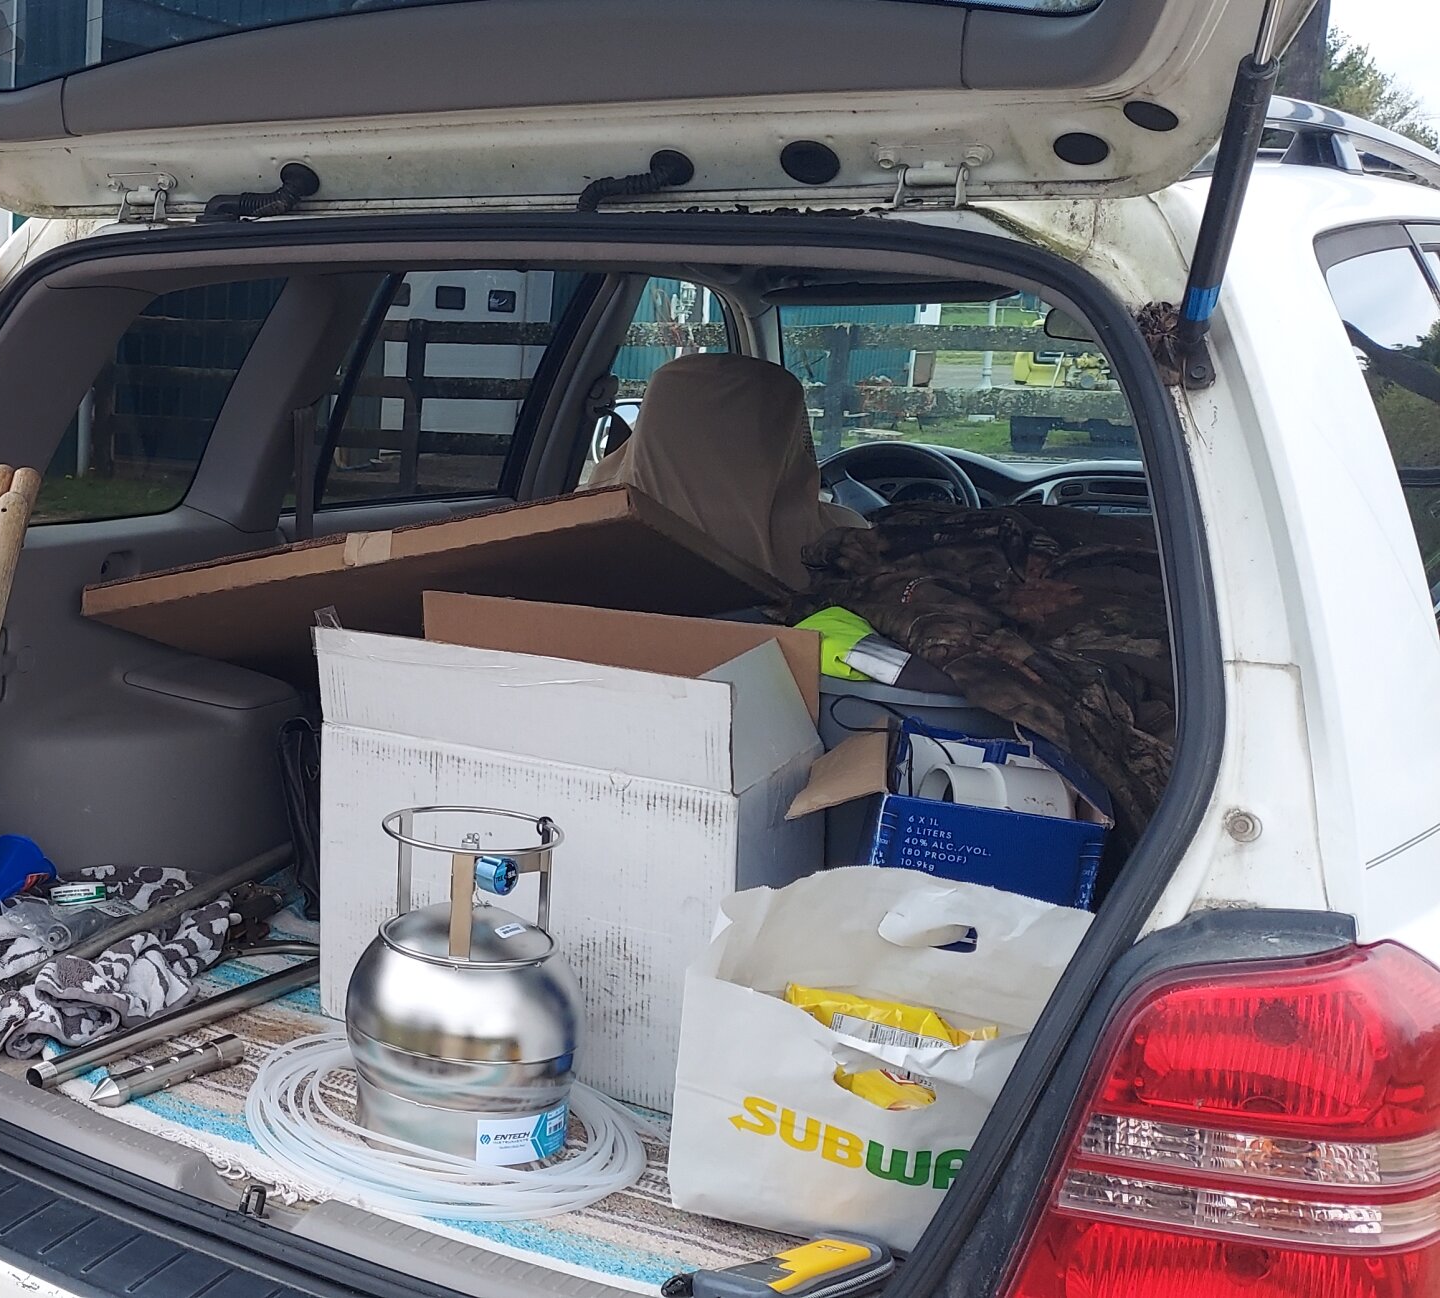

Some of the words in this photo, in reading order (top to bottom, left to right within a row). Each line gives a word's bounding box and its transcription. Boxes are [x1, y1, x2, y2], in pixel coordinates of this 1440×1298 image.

[908, 815, 915, 823] 6
[918, 816, 925, 824] X
[929, 818, 939, 827] 1L
[906, 826, 913, 834] 6
[916, 827, 952, 839] LITERS
[904, 837, 928, 847] 40%
[931, 841, 992, 857] ALC./VOL.
[902, 847, 921, 857] (80
[925, 851, 967, 864] PROOF)
[900, 858, 935, 872] 10.9kg
[493, 1132, 530, 1141] ENTECH
